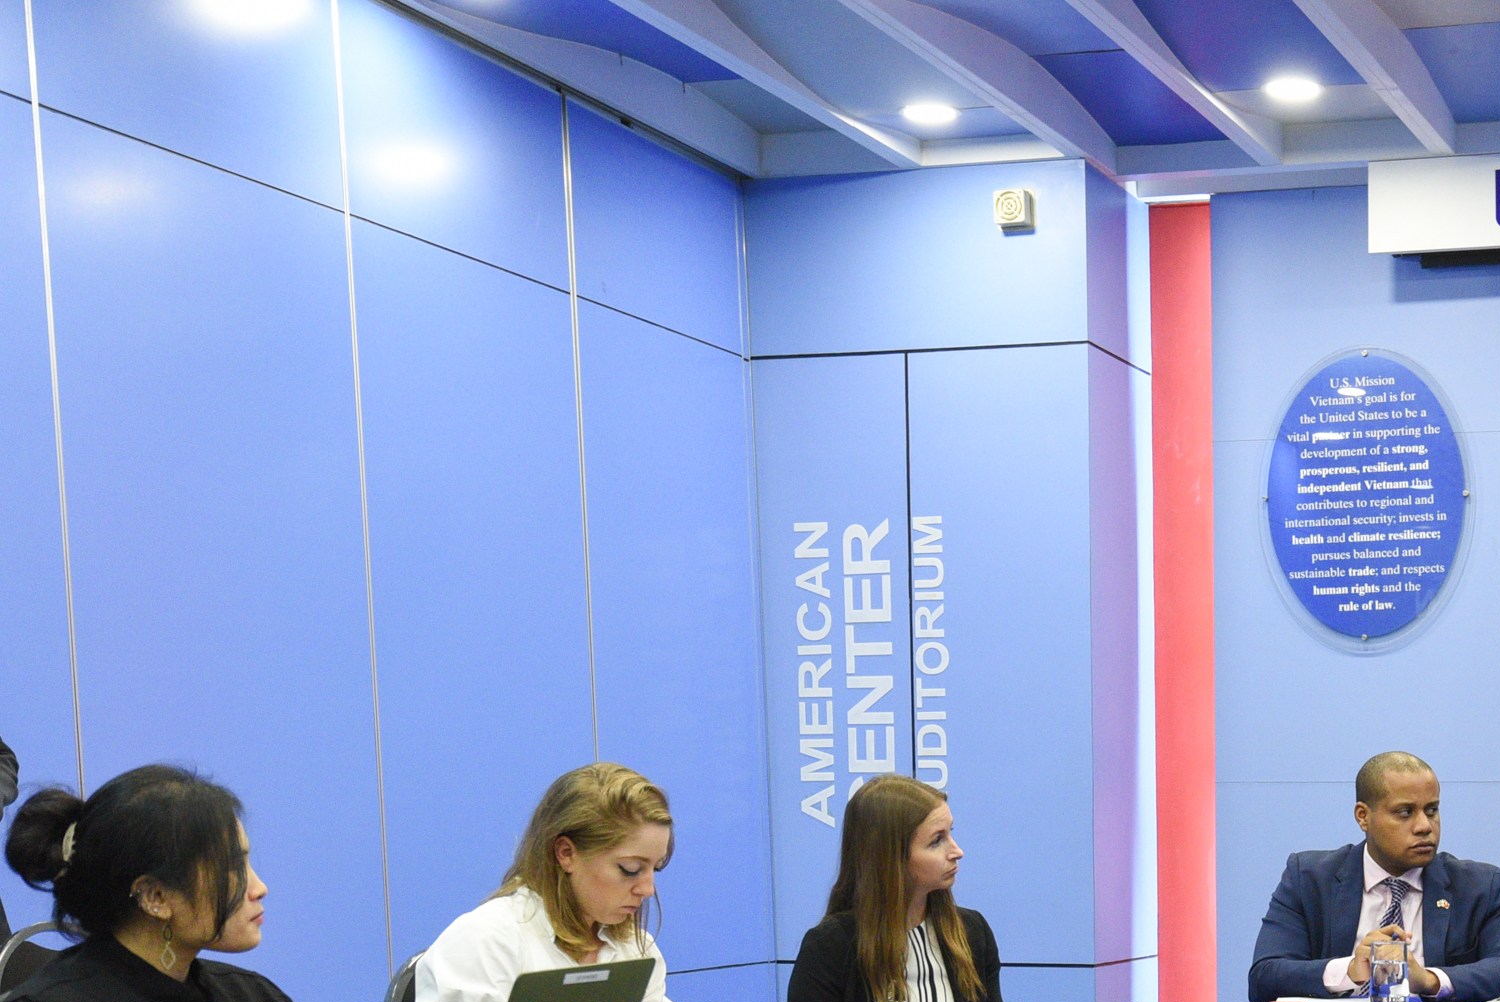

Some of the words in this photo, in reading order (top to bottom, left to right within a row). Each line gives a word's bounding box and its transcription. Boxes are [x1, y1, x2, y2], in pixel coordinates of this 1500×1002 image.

[1330, 377, 1352, 389] U.S.
[1355, 375, 1395, 387] Mission
[1365, 392, 1386, 406] goal
[1389, 392, 1398, 402] is
[1400, 391, 1416, 401] for
[1300, 414, 1316, 424] the
[1319, 411, 1355, 423] United
[1358, 410, 1389, 421] States
[1391, 410, 1403, 419] to
[1405, 408, 1418, 418] be
[1287, 431, 1309, 442] vital
[1353, 428, 1363, 438] in
[1365, 425, 1421, 440] supporting
[1424, 424, 1440, 434] the
[1300, 447, 1367, 460] development
[1370, 444, 1381, 455] of
[1392, 444, 1428, 455] strong,
[1300, 466, 1360, 479] prosperous,
[1362, 462, 1407, 473] resilient,
[1409, 459, 1429, 470] and
[1297, 481, 1361, 496] independent
[1364, 480, 1409, 490] Vietnam
[1296, 499, 1354, 511] contributes
[1356, 499, 1367, 508] to
[1370, 495, 1412, 509] regional
[1415, 494, 1434, 505] and
[1285, 515, 1350, 528] international
[1353, 513, 1396, 526] security;
[1399, 512, 1434, 523] invests
[1437, 510, 1447, 521] in
[1292, 534, 1324, 545] health
[1327, 533, 1346, 543] and
[1348, 532, 1386, 542] climate
[1388, 529, 1441, 540] resilience;
[1311, 552, 1351, 564] pursues
[1353, 547, 1399, 559] balanced
[1402, 546, 1421, 557] and
[1289, 567, 1346, 579] sustainable
[1348, 566, 1378, 577] trade;
[1381, 564, 1400, 575] and
[1403, 564, 1445, 576] respects
[1313, 585, 1348, 595] human
[1351, 583, 1380, 596] rights
[1382, 582, 1402, 592] and
[1404, 581, 1421, 591] the
[1339, 601, 1359, 611] rule
[1361, 600, 1374, 610] of
[1375, 600, 1396, 610] law.
[842, 517, 896, 802] ENTER
[911, 515, 950, 792] UDITORIUM
[793, 521, 836, 828] AMERICAN
